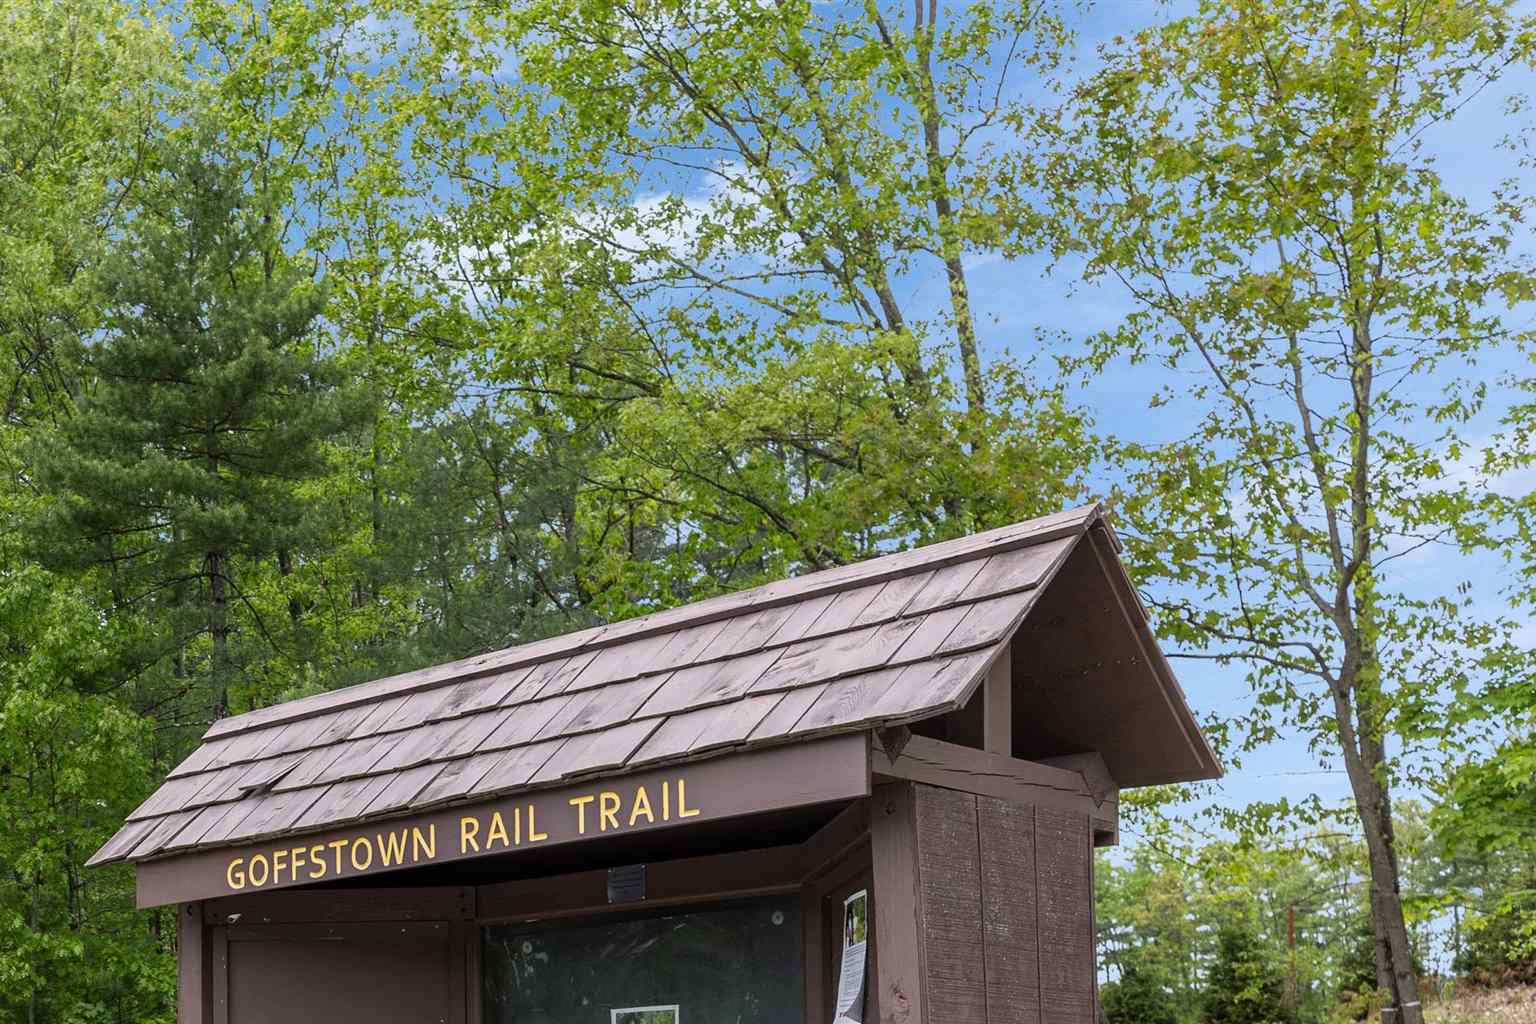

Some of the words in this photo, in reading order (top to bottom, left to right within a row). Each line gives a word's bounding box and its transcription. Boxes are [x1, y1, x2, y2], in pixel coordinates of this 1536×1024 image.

[226, 823, 437, 891] GOFFSTOWN
[460, 804, 548, 854] RAIL
[568, 778, 701, 835] TRAIL
